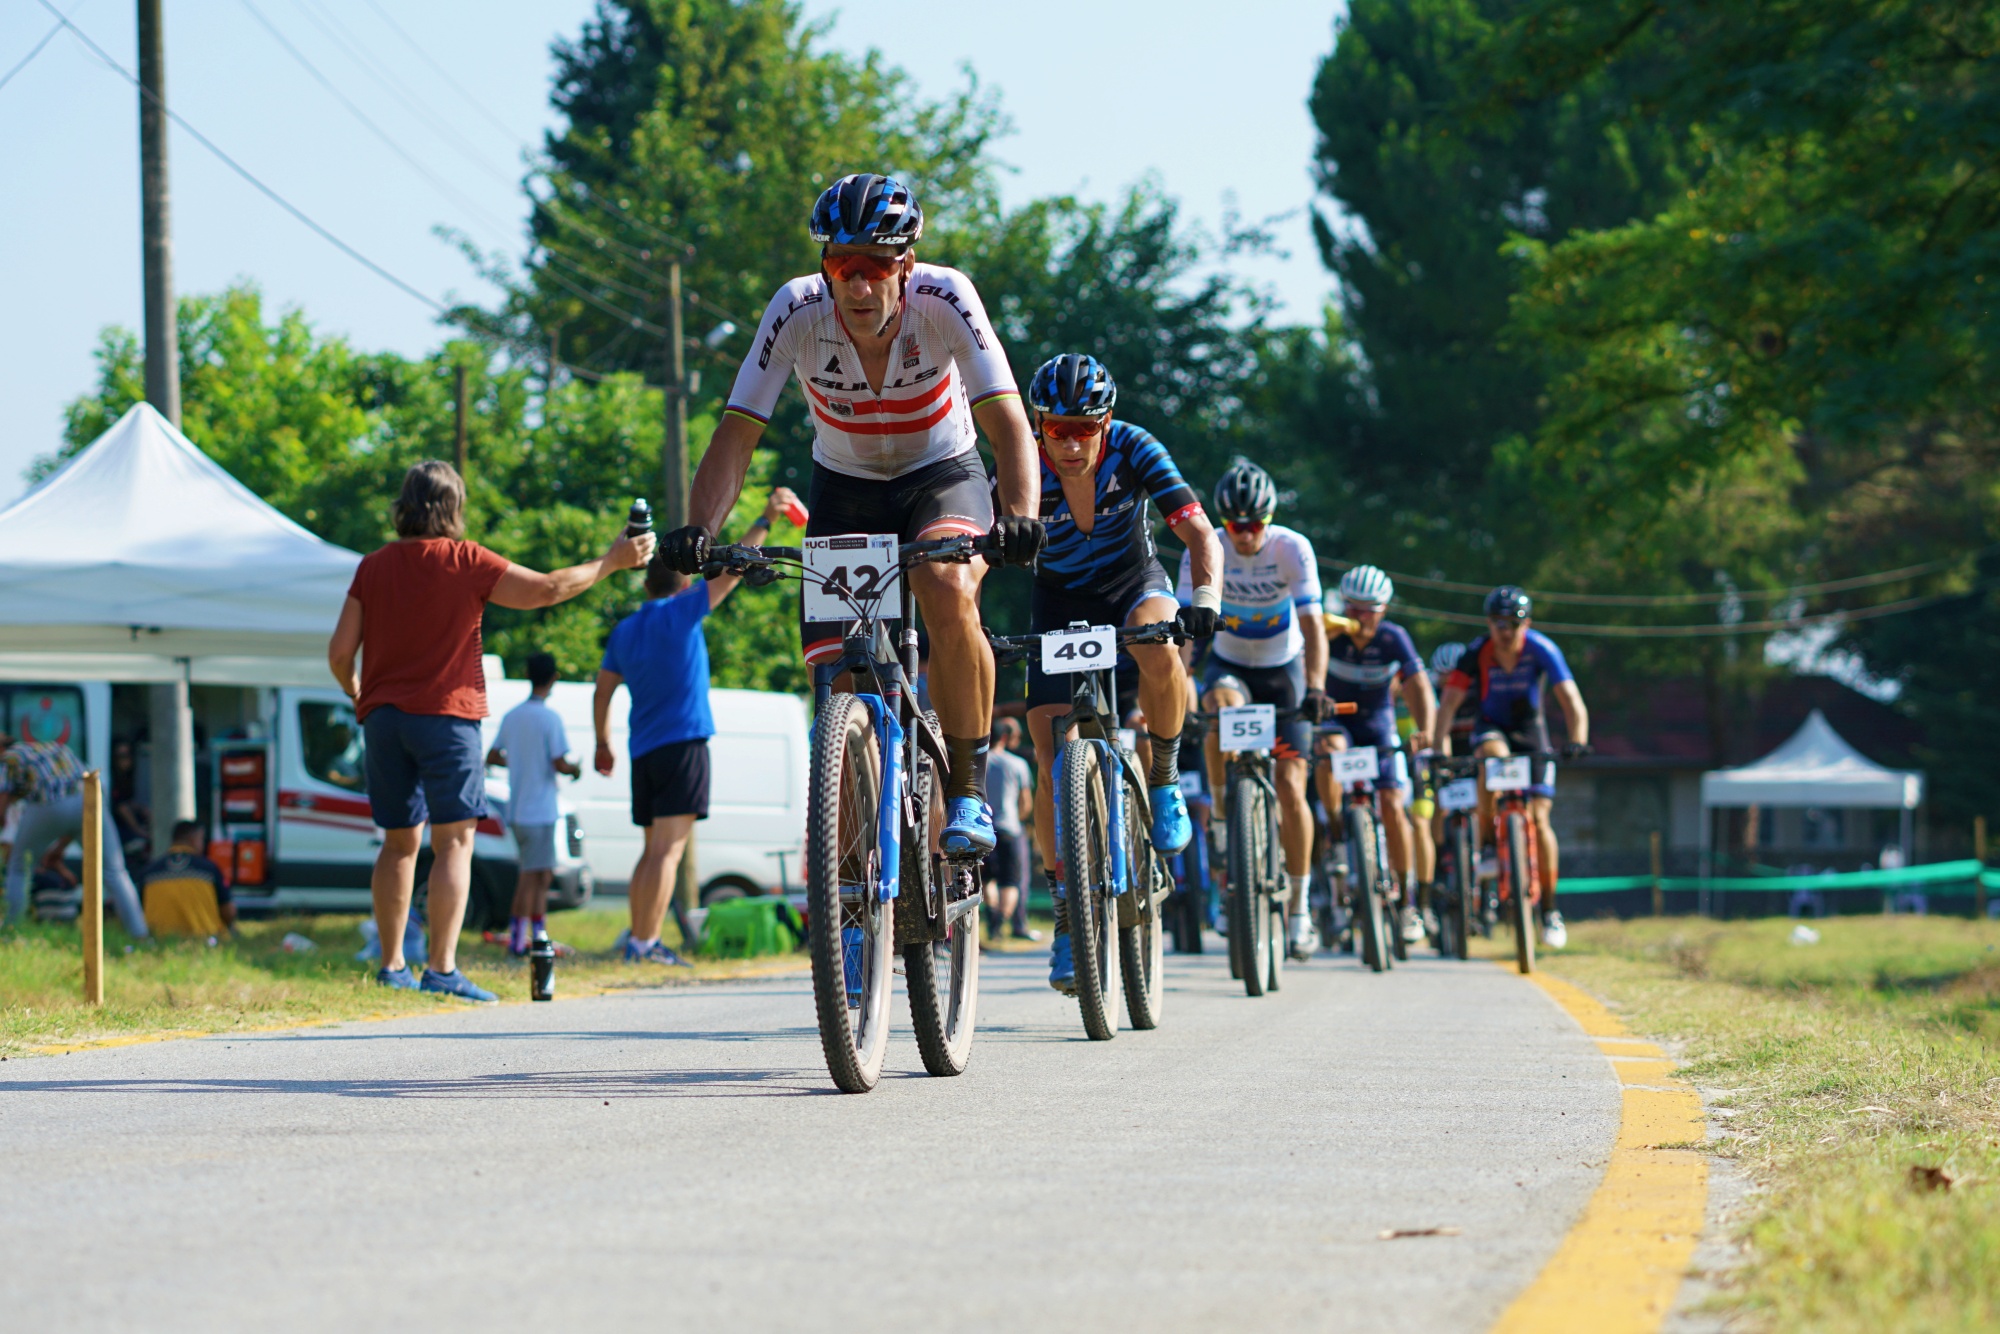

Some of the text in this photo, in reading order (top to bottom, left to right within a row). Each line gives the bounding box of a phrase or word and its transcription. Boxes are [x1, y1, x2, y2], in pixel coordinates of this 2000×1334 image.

[876, 236, 908, 245] LAZER
[915, 284, 989, 350] BULLS
[758, 293, 823, 371] BULLS
[695, 535, 704, 563] ERGON
[809, 540, 828, 549] UCI
[821, 565, 881, 601] 42
[1053, 640, 1103, 661] 40
[1232, 721, 1262, 737] 55
